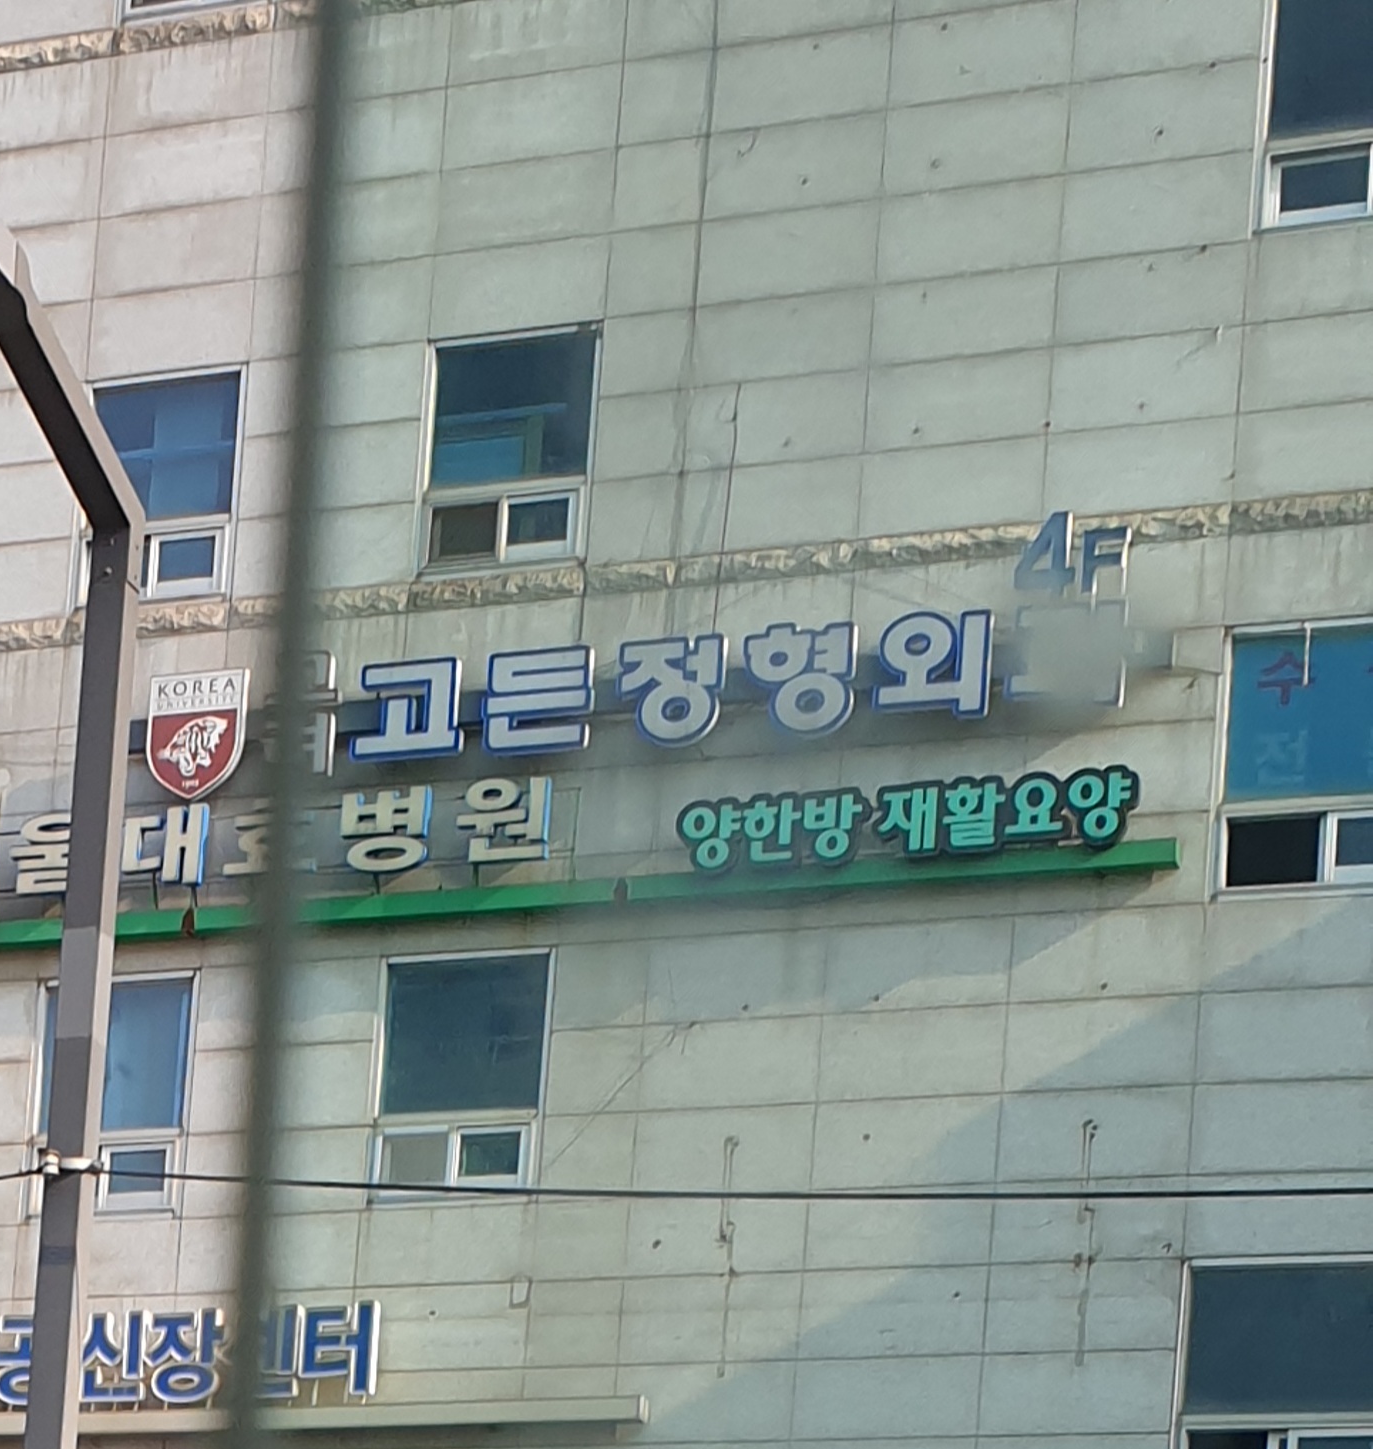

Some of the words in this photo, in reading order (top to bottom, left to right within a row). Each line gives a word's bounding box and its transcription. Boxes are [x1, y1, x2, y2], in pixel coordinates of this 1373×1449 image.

[1014, 511, 1131, 600] 4F
[157, 695, 236, 711] UNIVERSITY
[158, 677, 236, 699] KOREA
[680, 792, 863, 870] 양한방
[878, 771, 1133, 852] 재활요양
